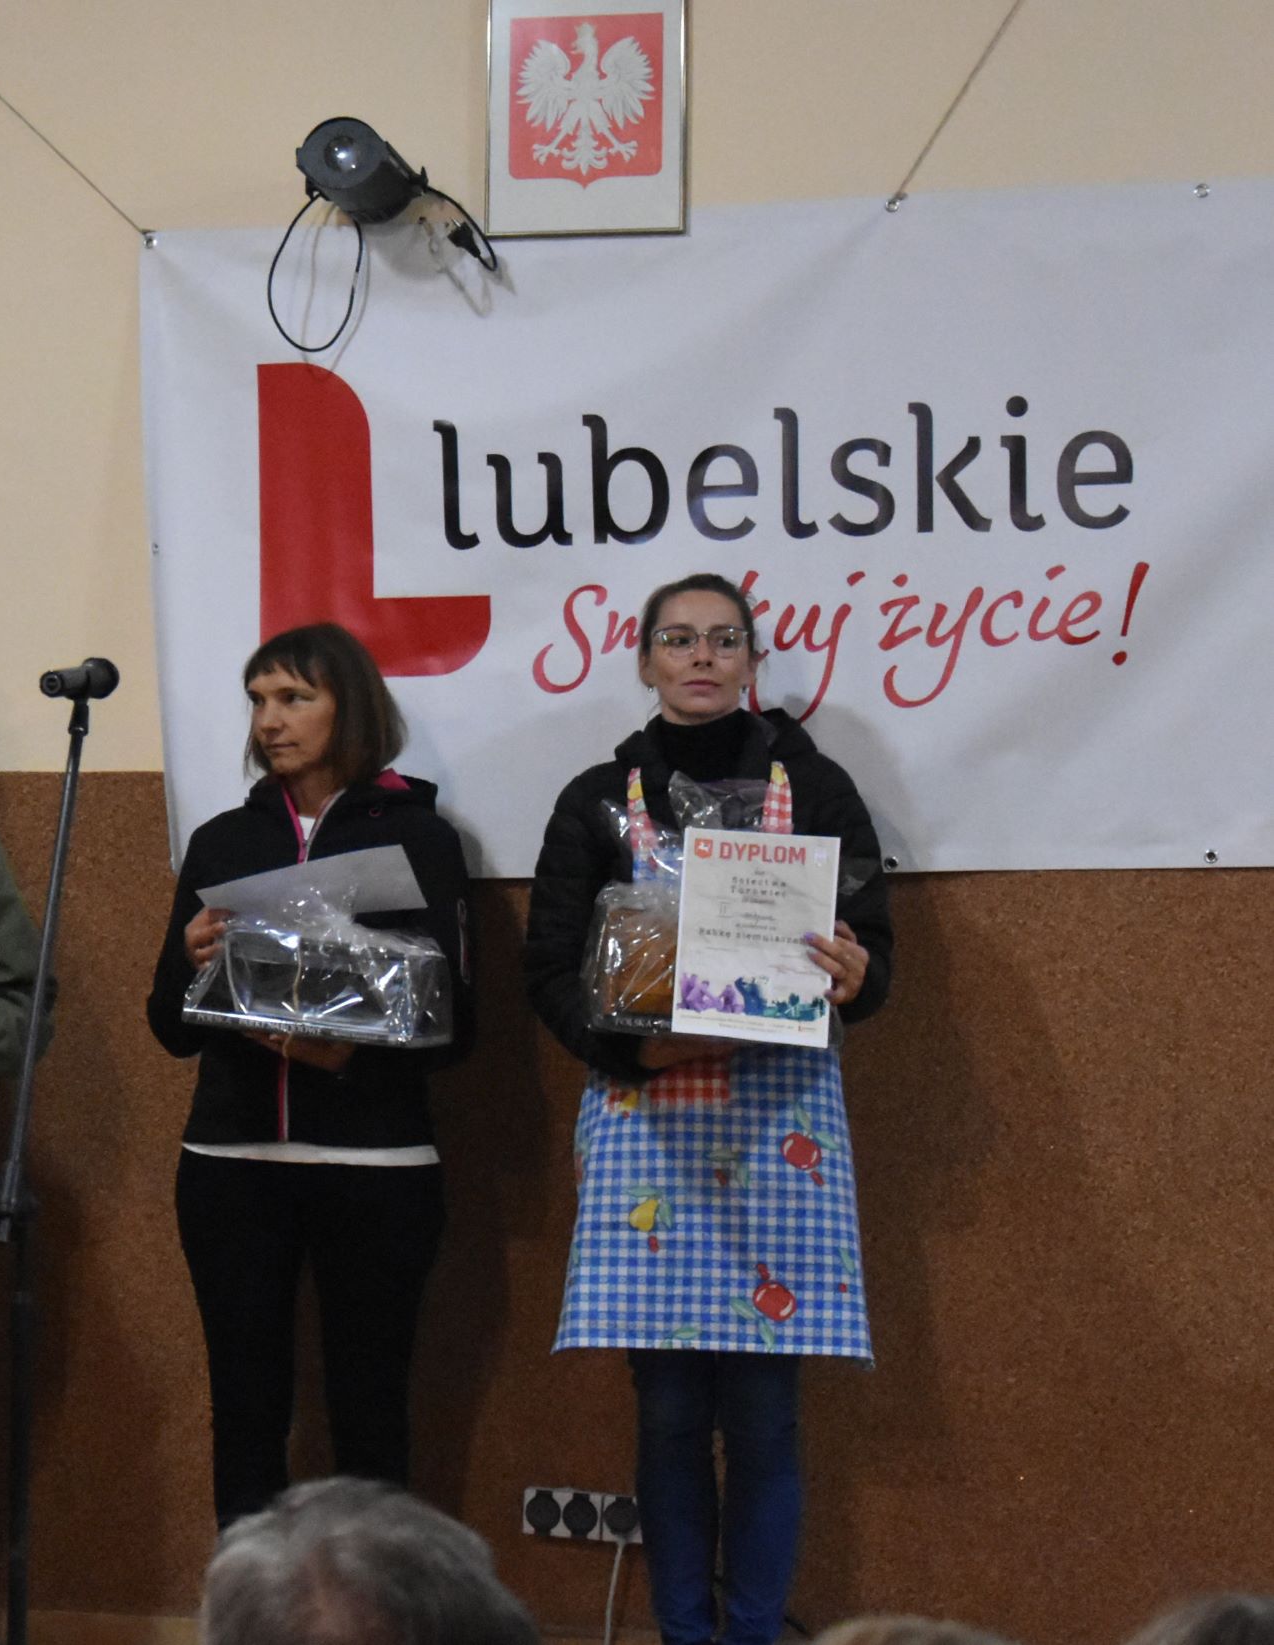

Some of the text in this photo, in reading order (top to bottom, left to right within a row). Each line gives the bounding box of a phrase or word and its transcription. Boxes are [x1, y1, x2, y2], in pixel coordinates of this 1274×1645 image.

[433, 396, 1134, 551] lubelskie
[533, 562, 1150, 722] Smuj życie!
[720, 842, 807, 864] DYPLOM
